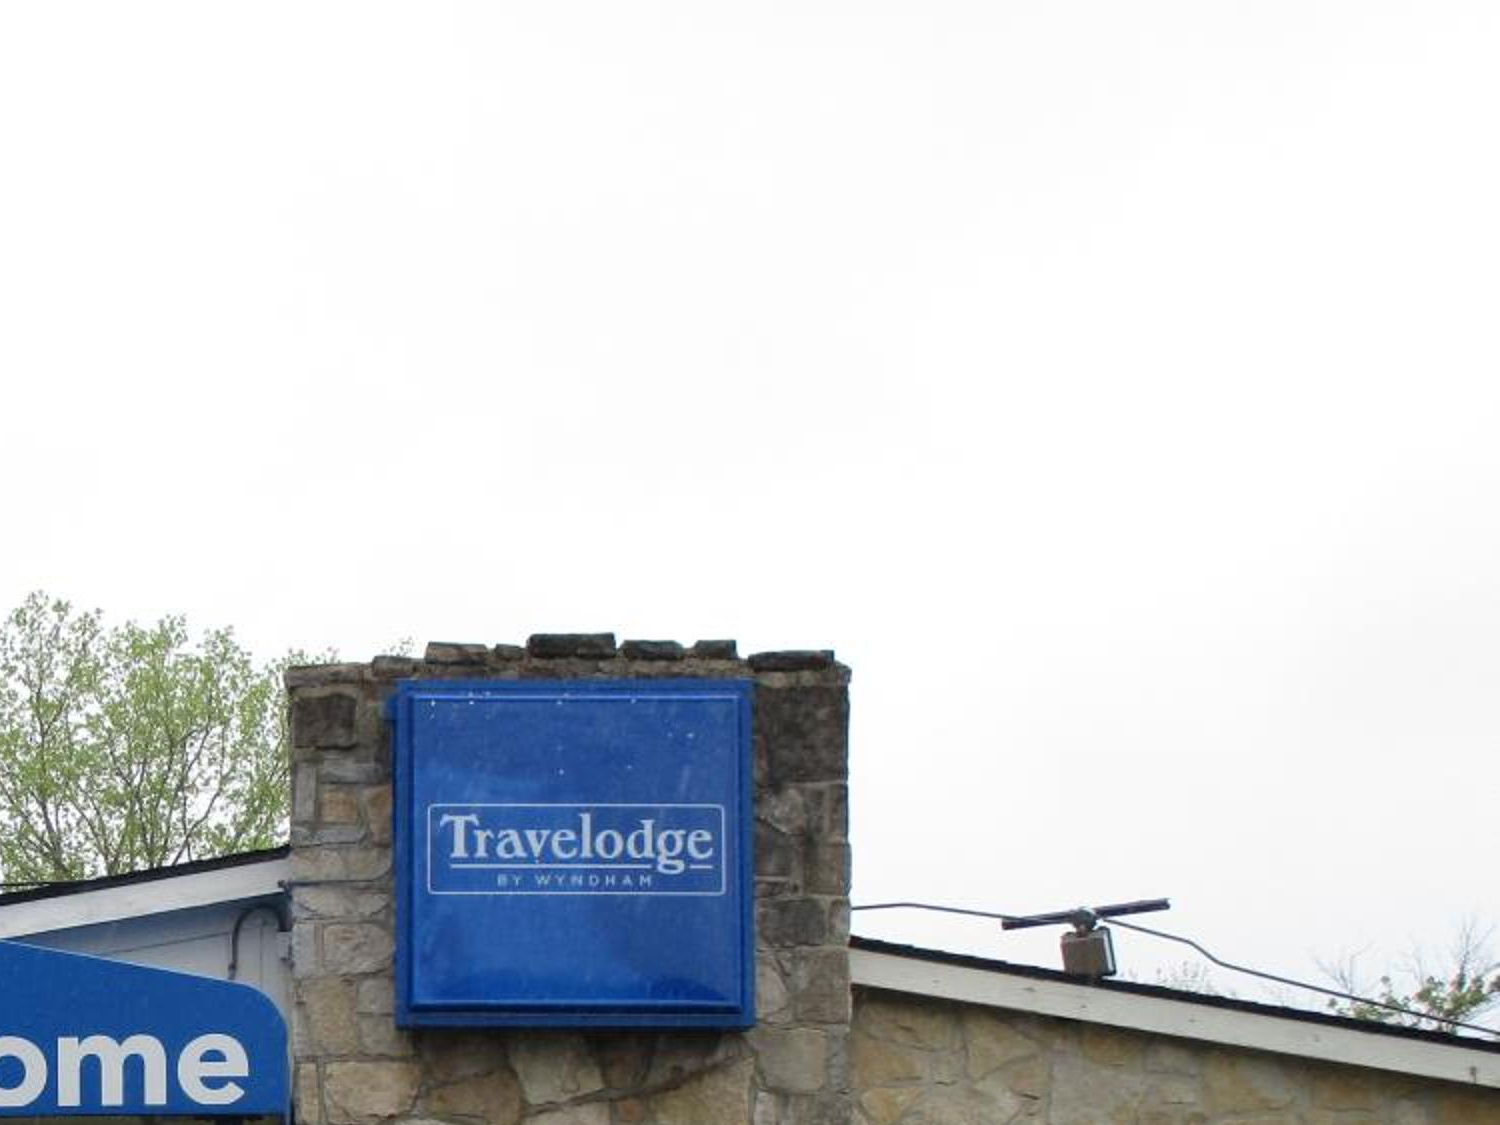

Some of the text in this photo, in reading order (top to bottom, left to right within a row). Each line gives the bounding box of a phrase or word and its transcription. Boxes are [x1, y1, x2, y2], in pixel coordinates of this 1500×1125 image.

[440, 813, 713, 874] Travelodge
[497, 875, 653, 887] BY WYNDHAM
